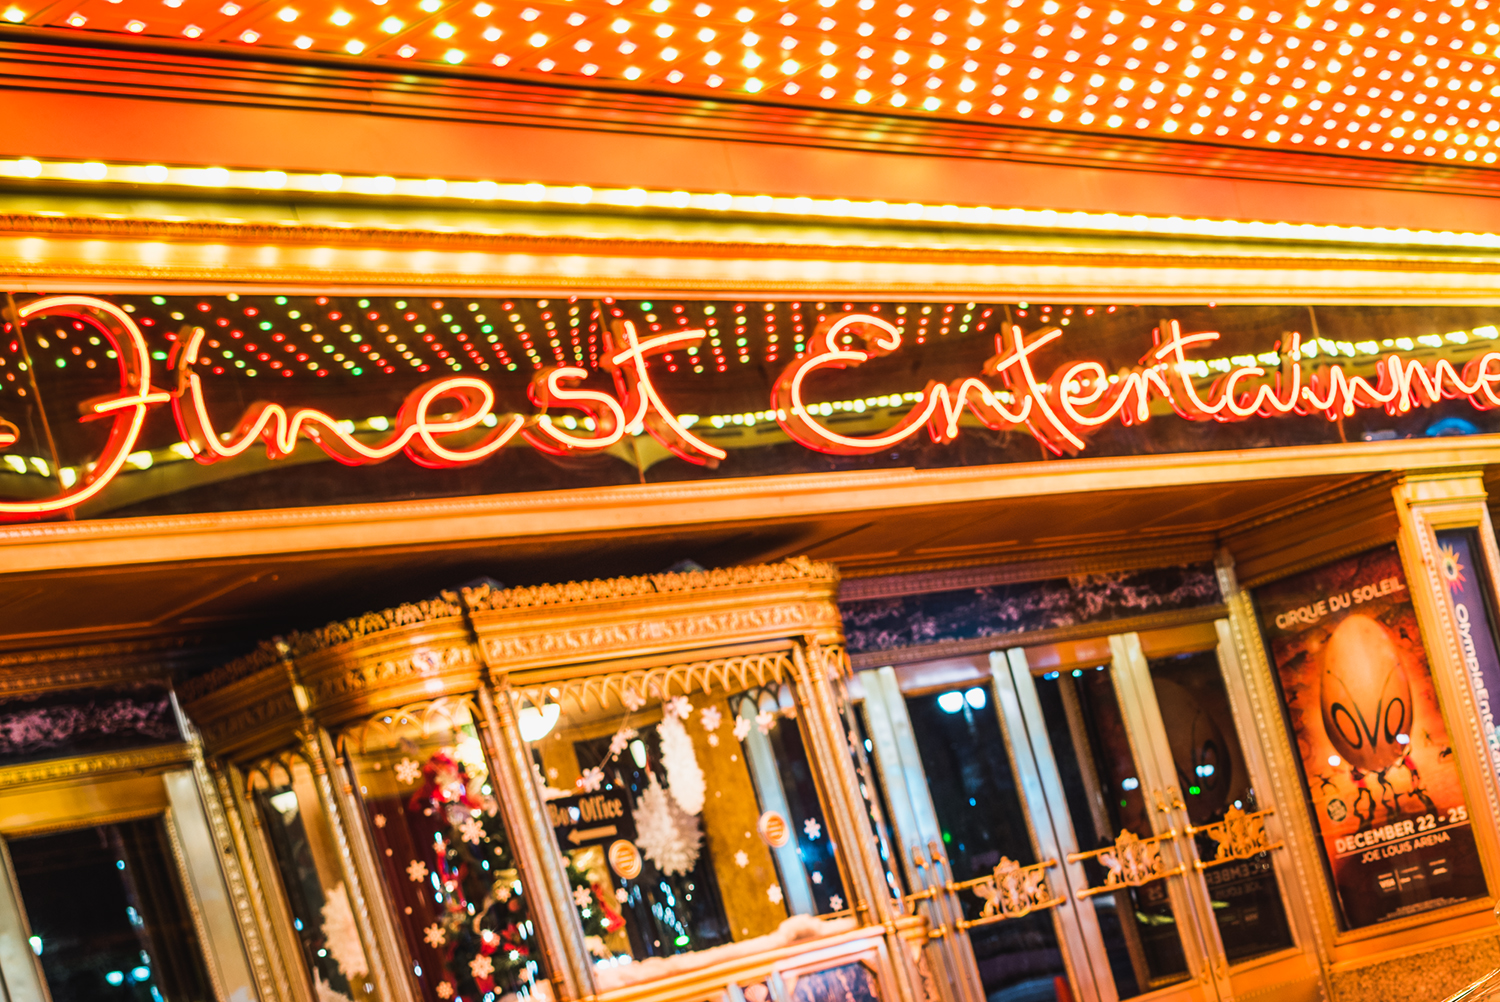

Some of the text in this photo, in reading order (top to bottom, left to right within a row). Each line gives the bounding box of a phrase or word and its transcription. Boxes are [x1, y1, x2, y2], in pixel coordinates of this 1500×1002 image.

[0, 296, 727, 512] Finest
[1275, 576, 1405, 630] CIRQUE DU SOLEIL
[1330, 697, 1405, 754] OVO
[578, 794, 624, 823] Office
[1334, 819, 1415, 854] DECEMBER
[1416, 813, 1436, 832] 22
[1447, 805, 1468, 823] 25
[1361, 831, 1450, 864] JOE LOUIS ARENA
